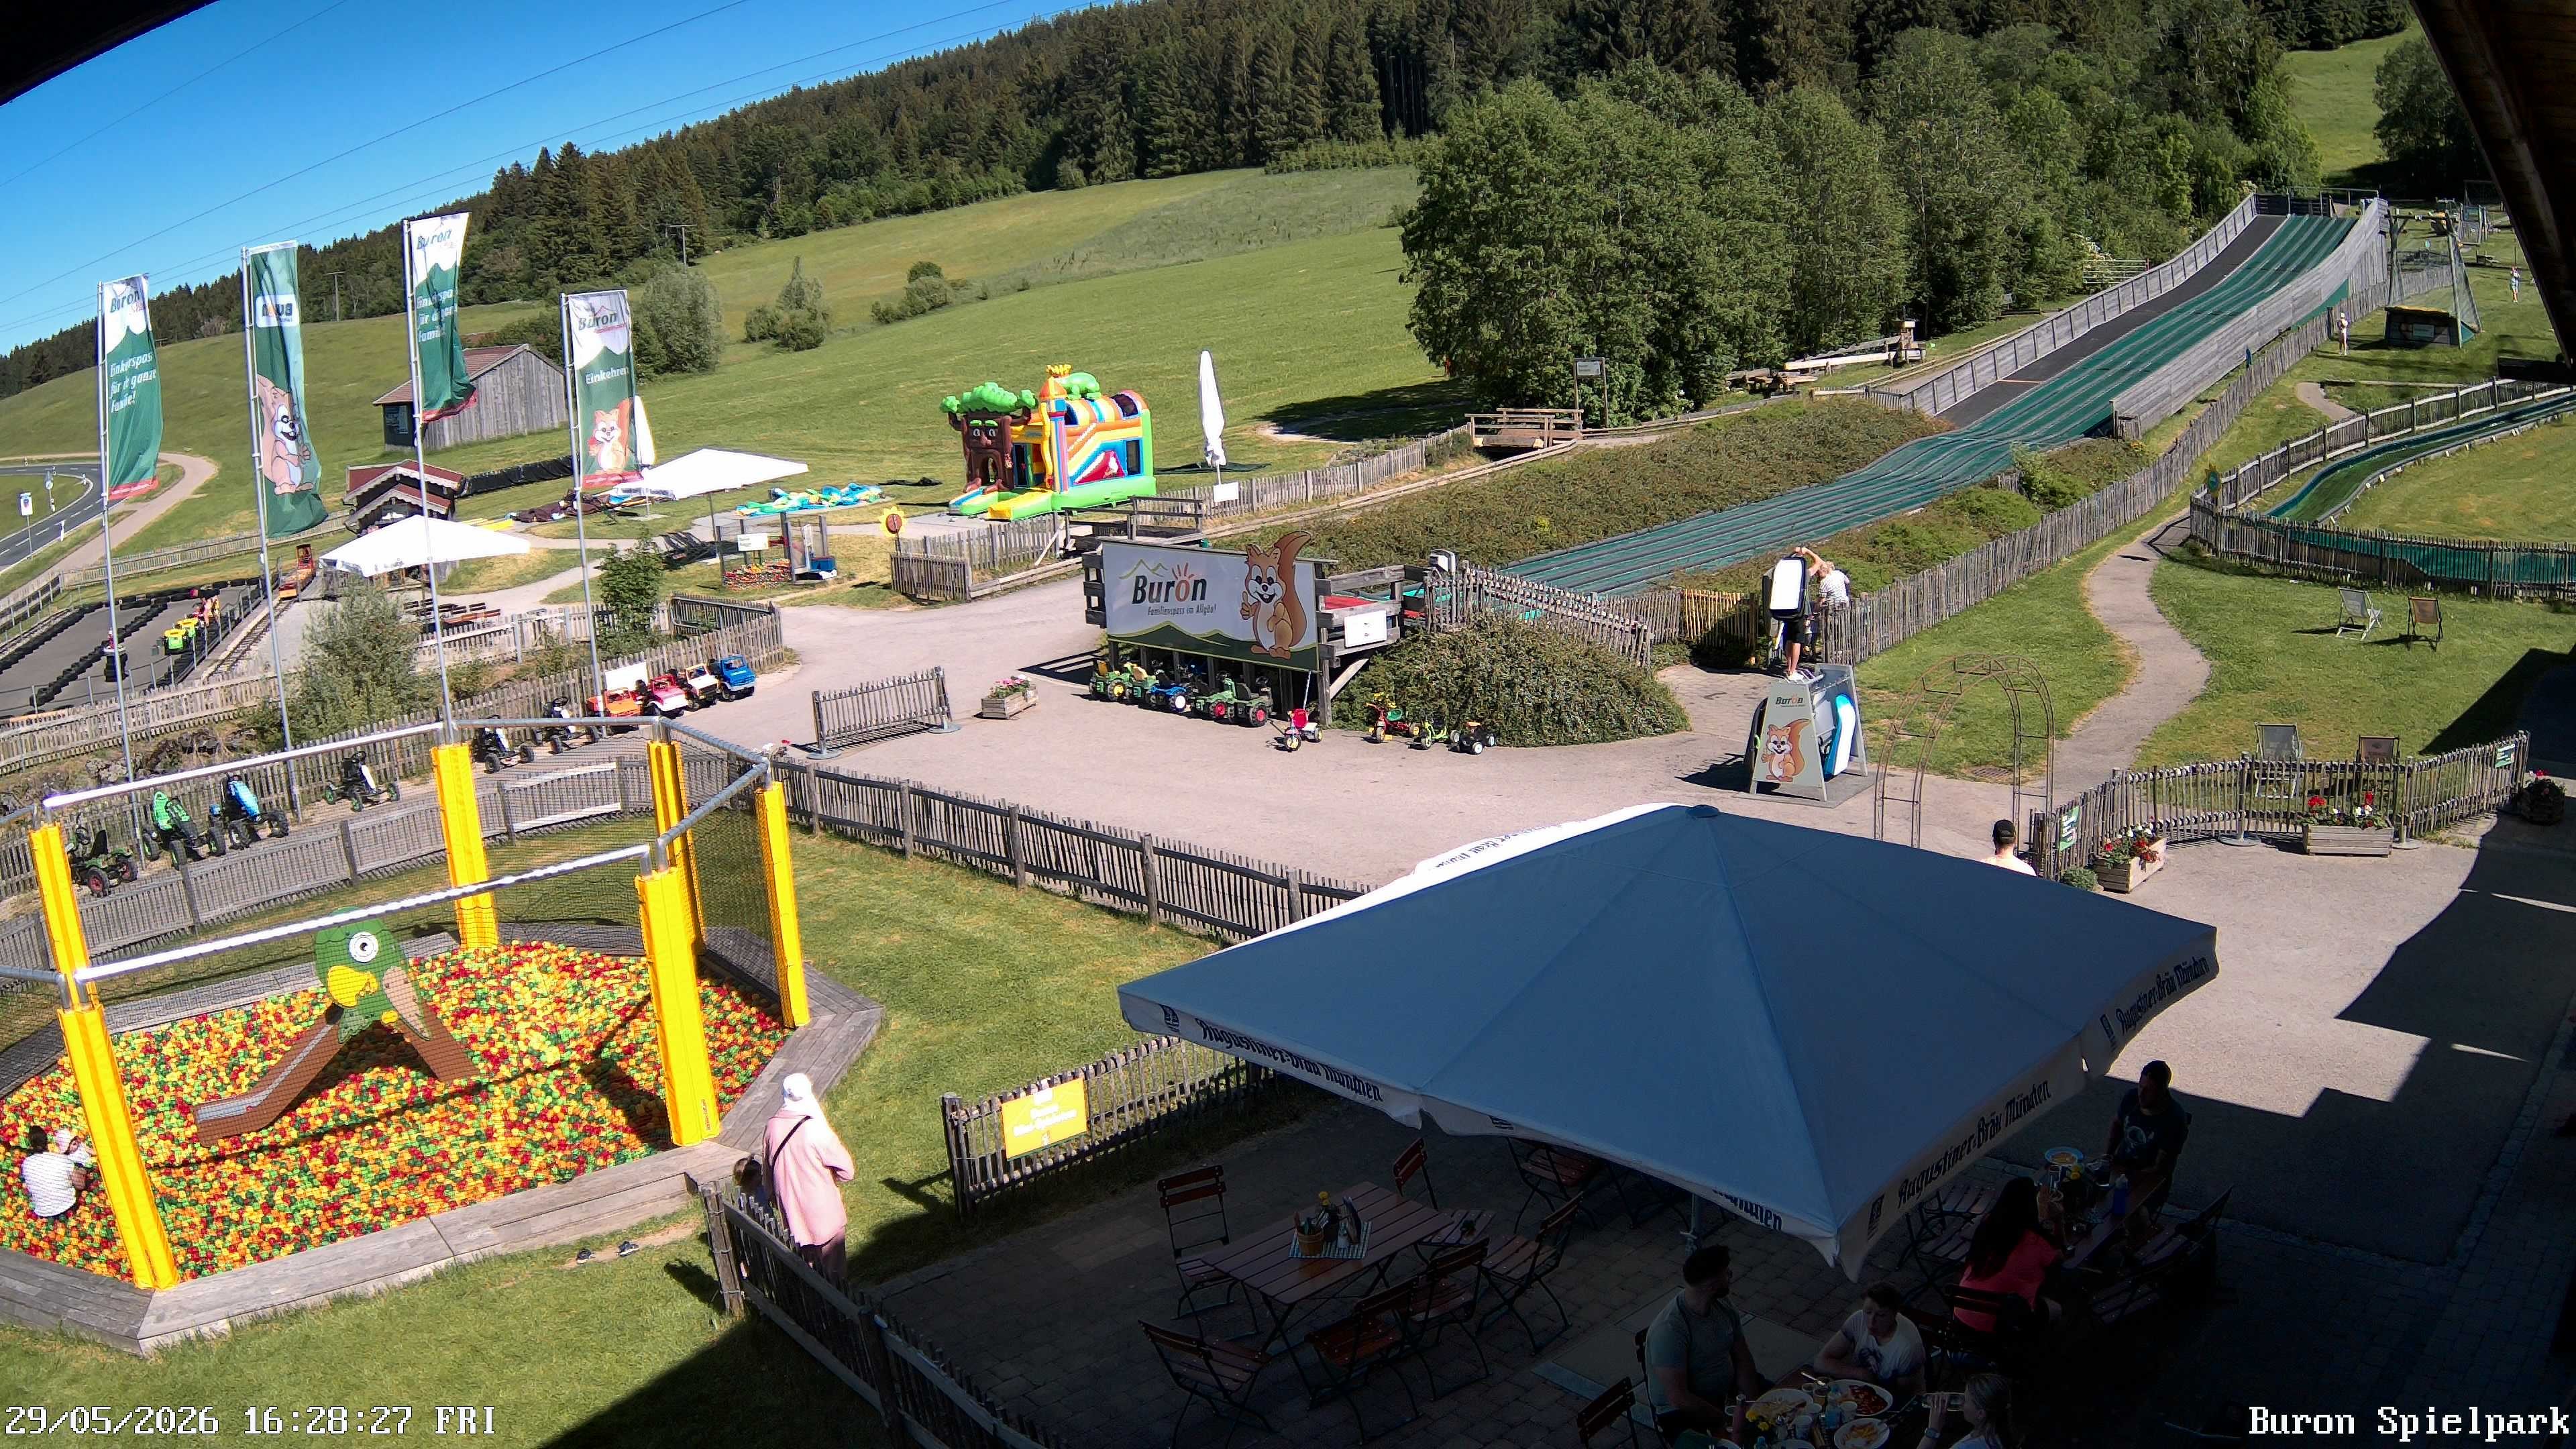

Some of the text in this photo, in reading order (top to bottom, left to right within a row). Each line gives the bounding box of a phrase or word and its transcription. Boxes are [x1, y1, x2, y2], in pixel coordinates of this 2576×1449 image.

[578, 313, 618, 331] Buron
[1132, 575, 1208, 604] Buron
[1186, 607, 1194, 615] im
[2004, 1080, 2051, 1128] München
